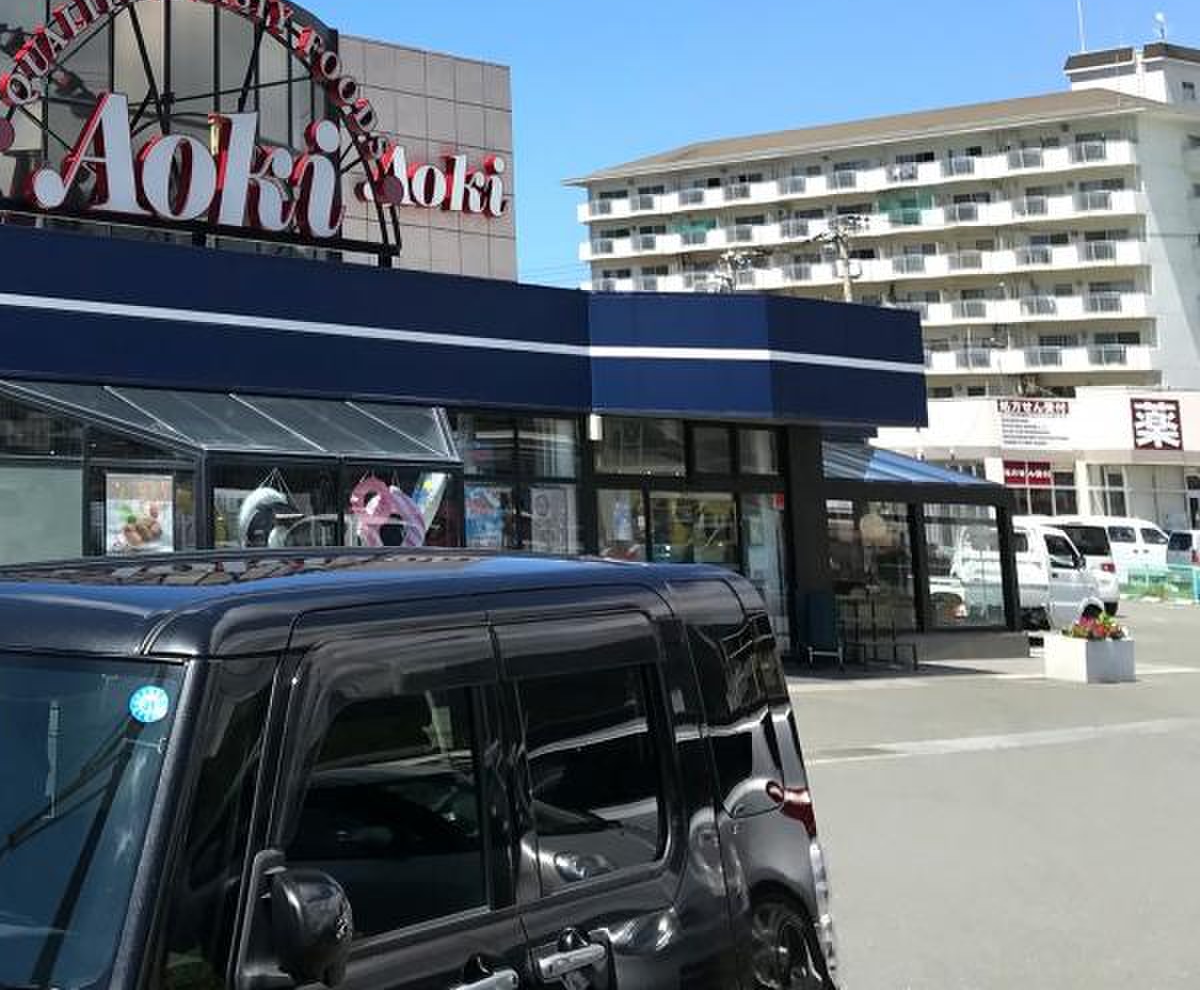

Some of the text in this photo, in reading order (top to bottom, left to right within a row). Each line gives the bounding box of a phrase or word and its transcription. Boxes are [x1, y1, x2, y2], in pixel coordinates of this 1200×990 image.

[30, 92, 345, 238] Aoki
[359, 143, 508, 217] Aoki
[1134, 401, 1181, 449] 薬
